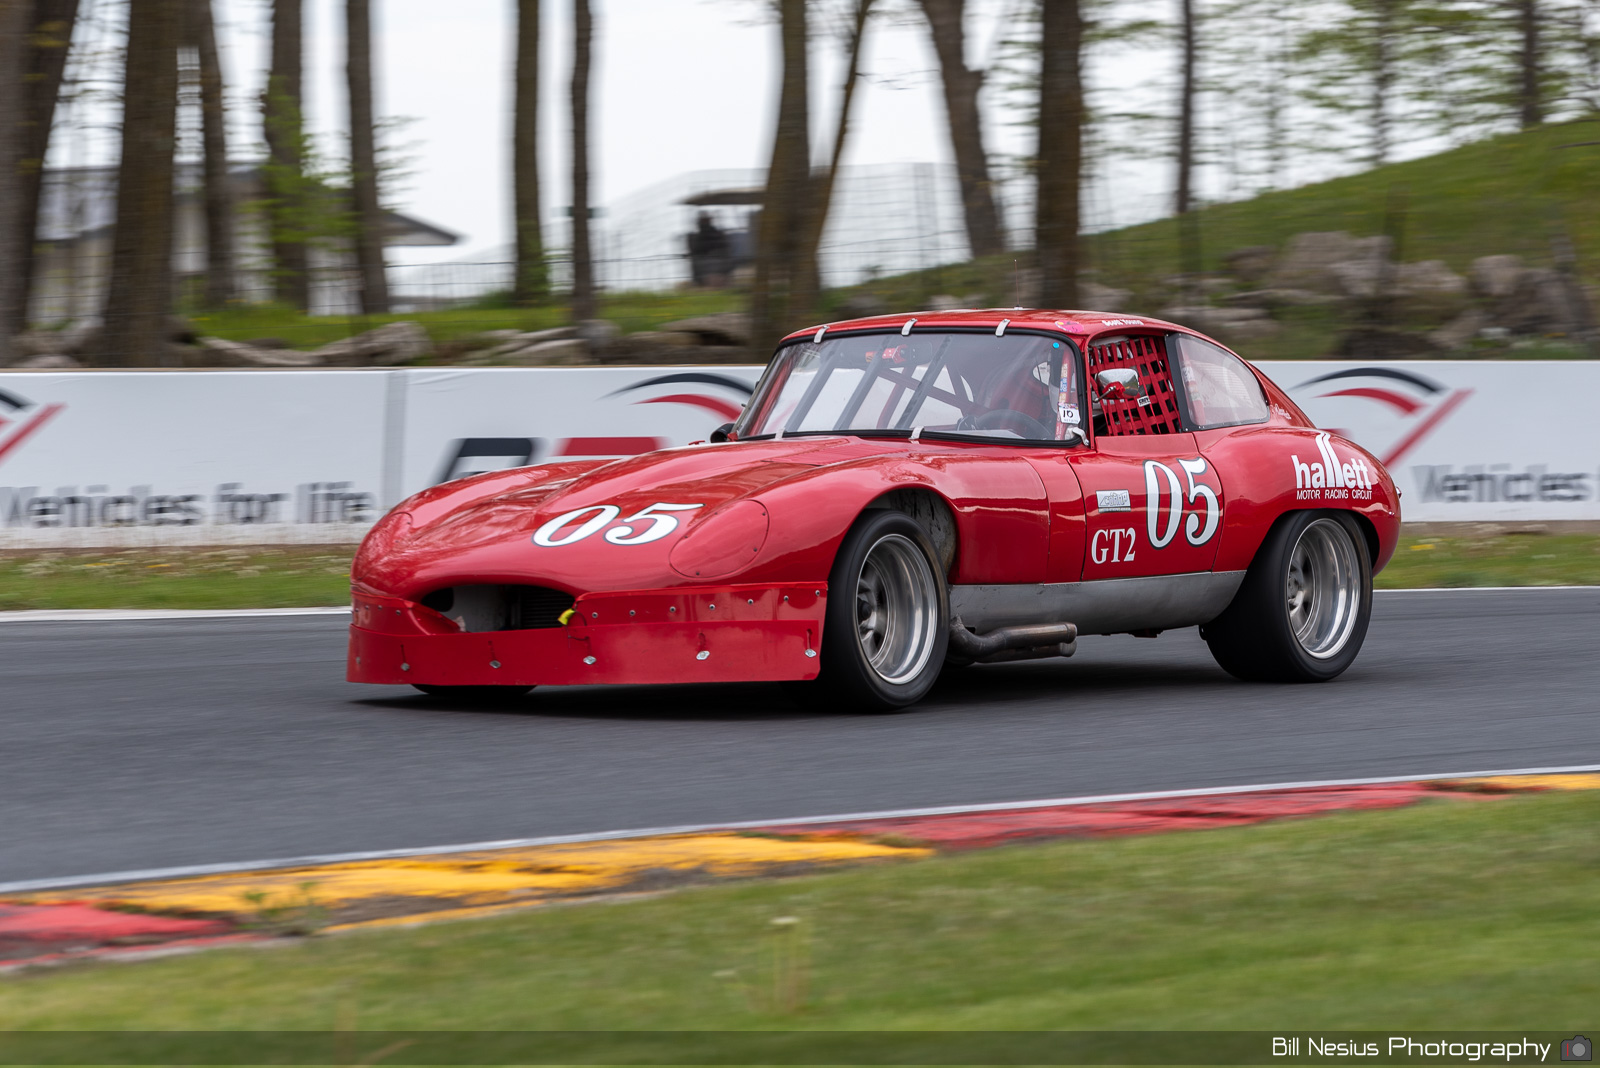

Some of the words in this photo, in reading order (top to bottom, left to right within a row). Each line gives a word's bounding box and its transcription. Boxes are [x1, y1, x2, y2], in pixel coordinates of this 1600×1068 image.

[1291, 432, 1372, 490] hallett
[215, 482, 291, 525] for
[296, 481, 374, 523] life
[1143, 457, 1220, 550] 05
[1296, 489, 1321, 500] MOTOR
[1324, 489, 1349, 500] RACING
[1351, 489, 1373, 500] CIRCUIT
[532, 502, 705, 547] 05
[1091, 527, 1136, 564] GT2
